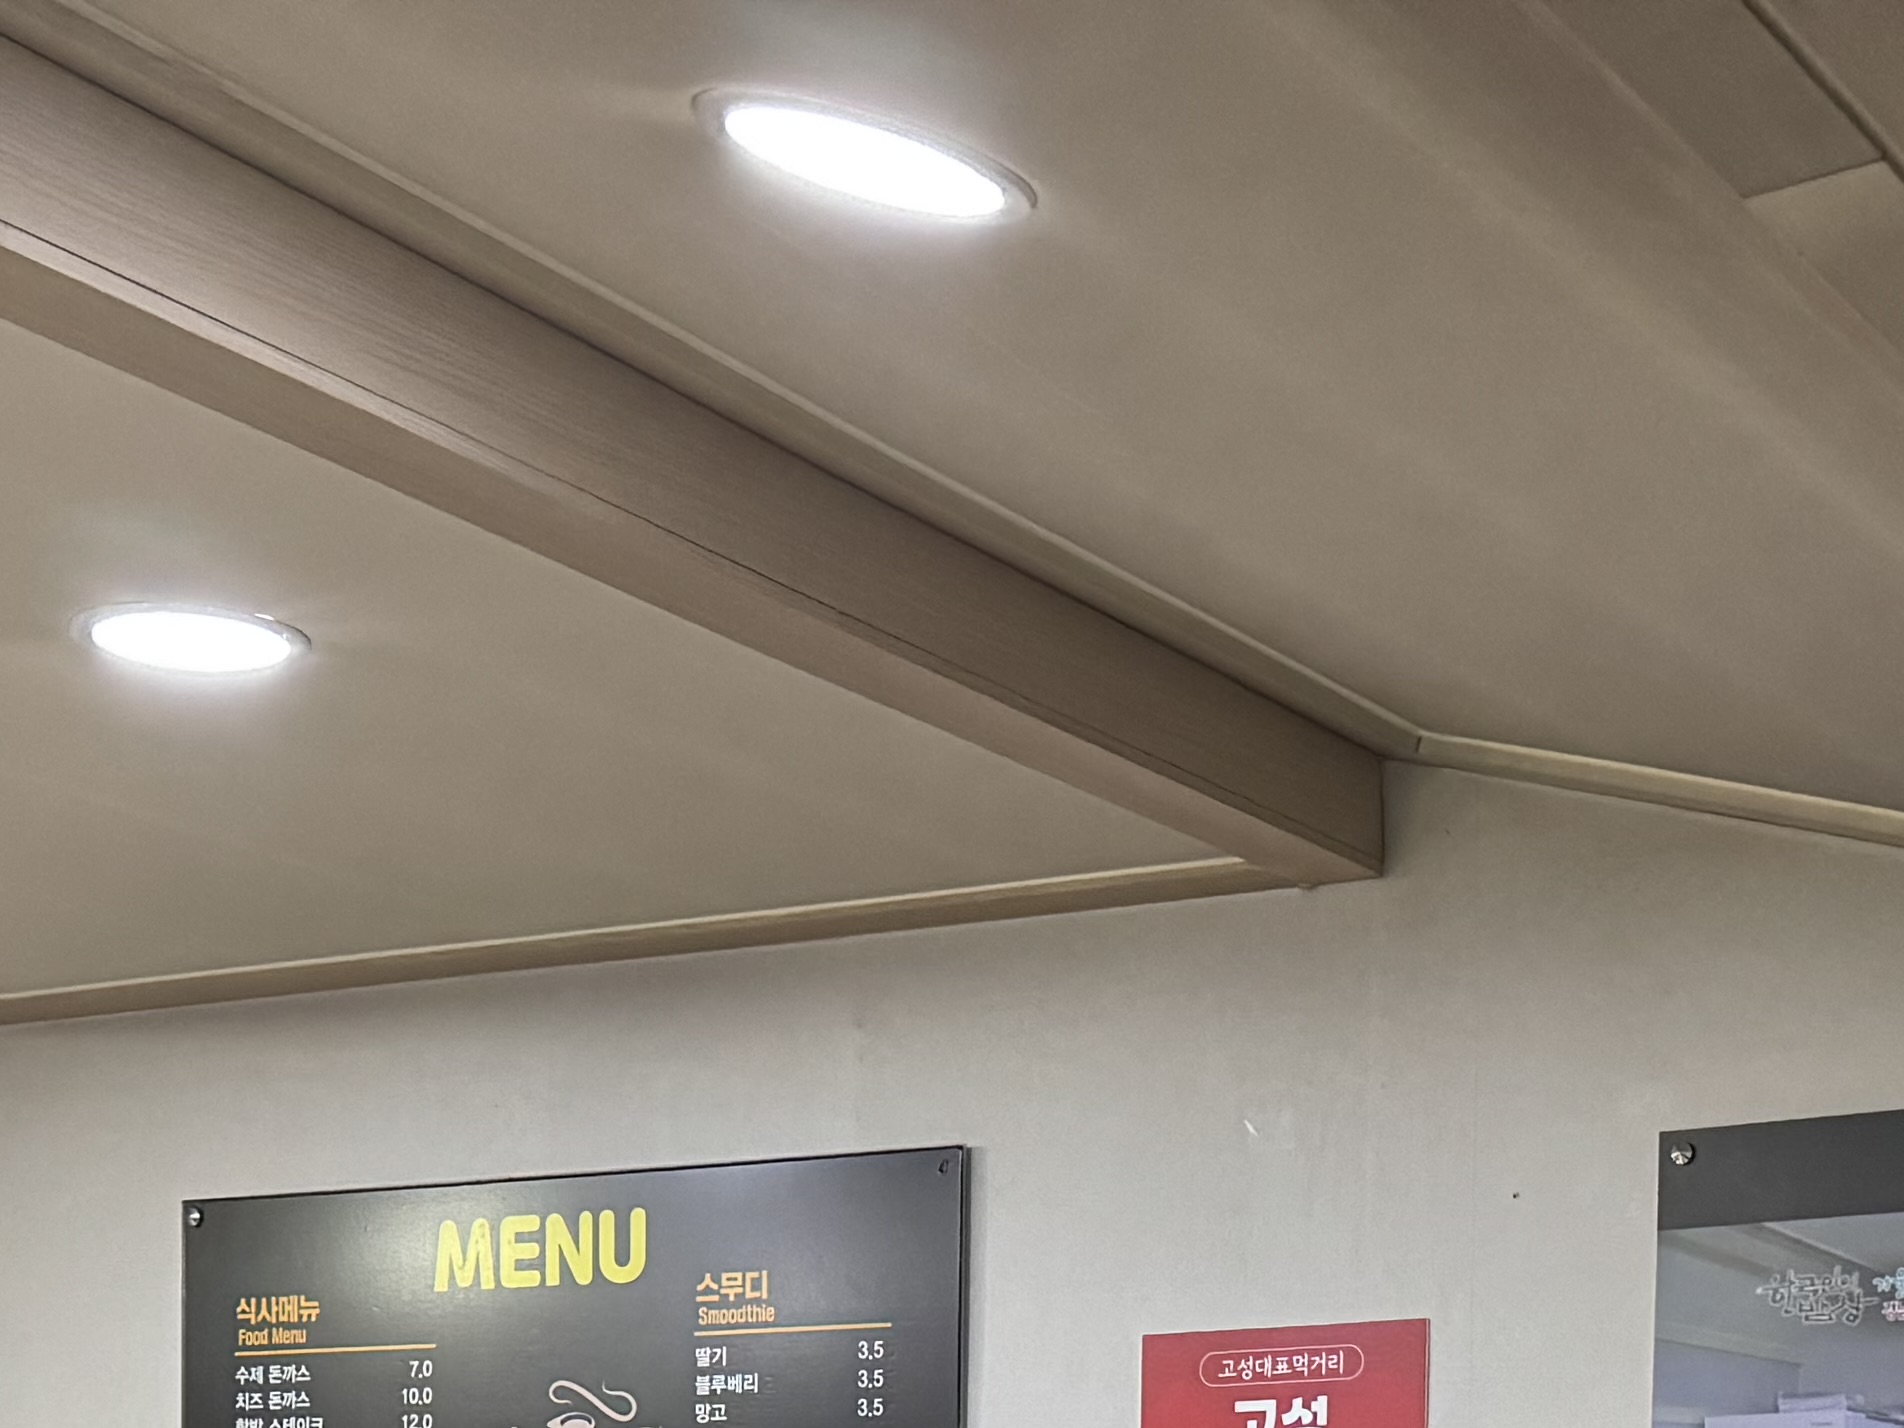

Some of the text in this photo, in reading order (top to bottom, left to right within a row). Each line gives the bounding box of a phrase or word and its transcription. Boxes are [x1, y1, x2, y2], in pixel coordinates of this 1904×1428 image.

[433, 1207, 646, 1292] MENU
[695, 1270, 768, 1302] 스무디
[236, 1295, 320, 1325] 식사메뉴
[698, 1304, 775, 1325] Smoothie
[239, 1327, 306, 1346] Food Menu
[695, 1340, 885, 1367] 딸기 3.5
[1218, 1350, 1344, 1381] 고성대표먹거리
[235, 1360, 433, 1385] 수제 돈까스 7.0
[695, 1369, 884, 1396] 블루베리 3.5
[235, 1387, 433, 1410] 치즈 돈까스 10.0
[695, 1398, 884, 1424] 망고 3.5
